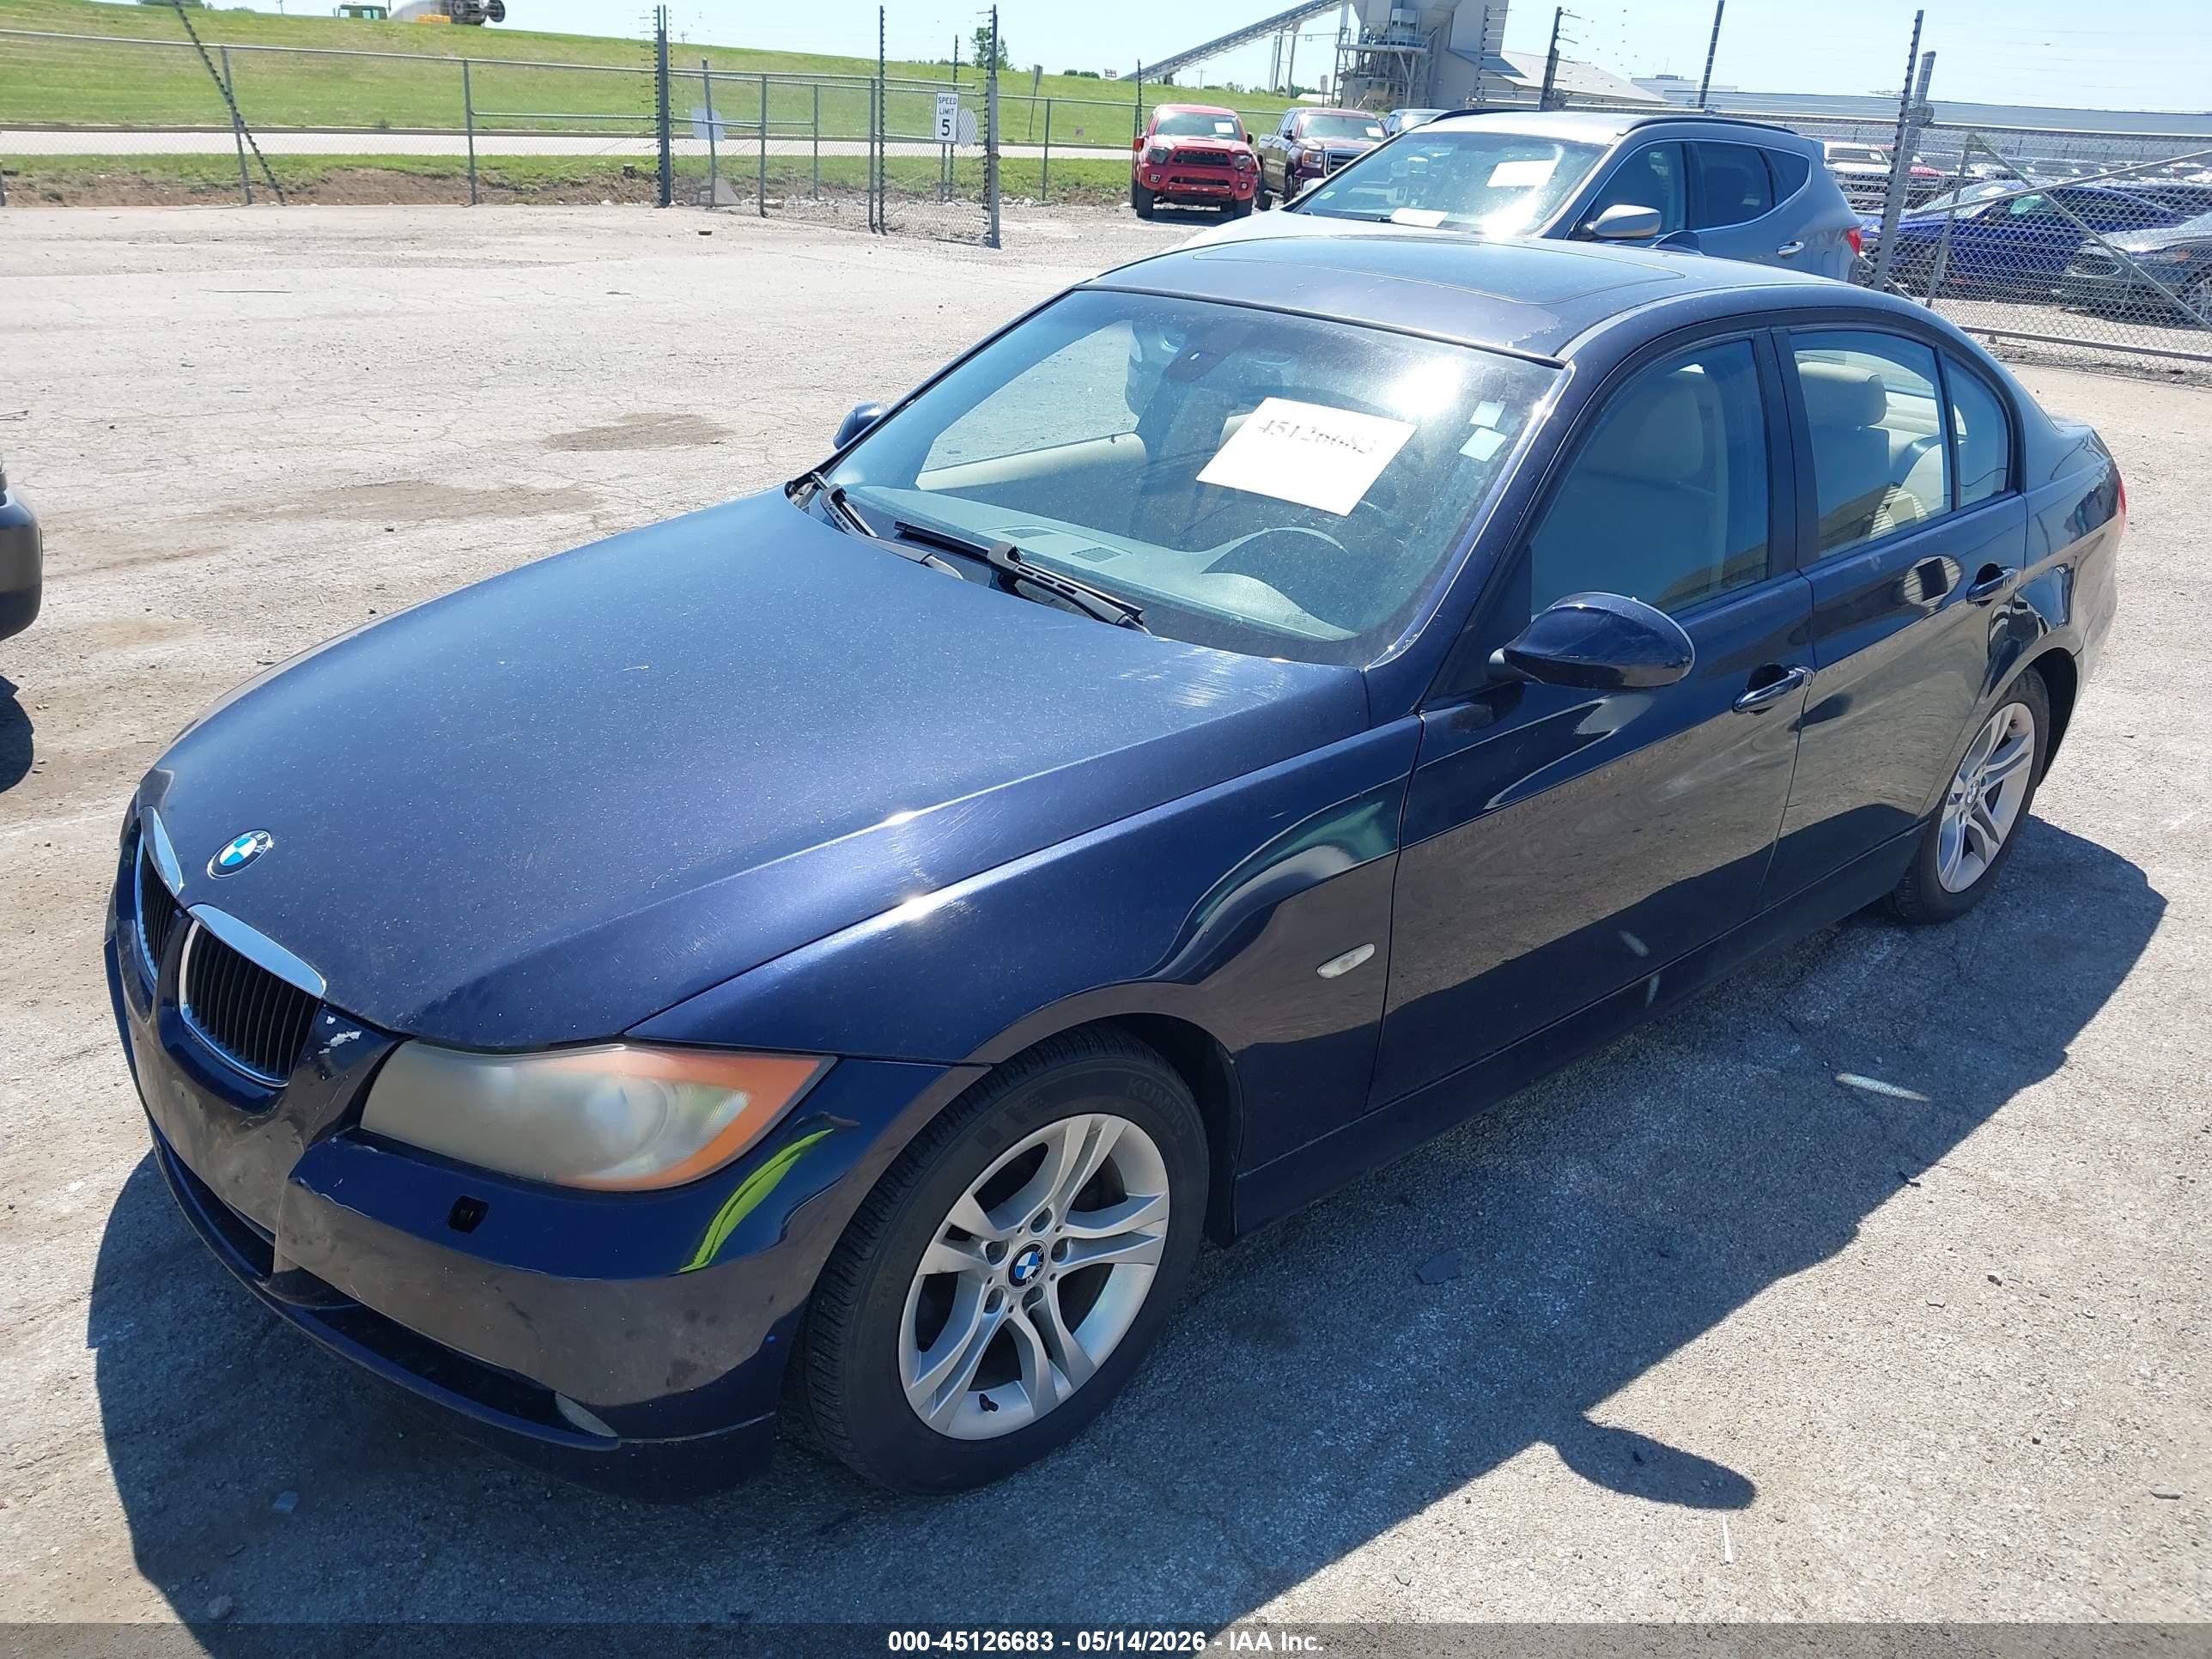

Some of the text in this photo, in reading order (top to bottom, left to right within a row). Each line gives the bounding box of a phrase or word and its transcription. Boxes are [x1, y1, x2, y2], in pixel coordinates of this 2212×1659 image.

[938, 96, 957, 105] SPEED
[939, 107, 955, 116] LIMIT
[941, 118, 951, 137] 5
[1127, 1078, 1189, 1135] KUMHO
